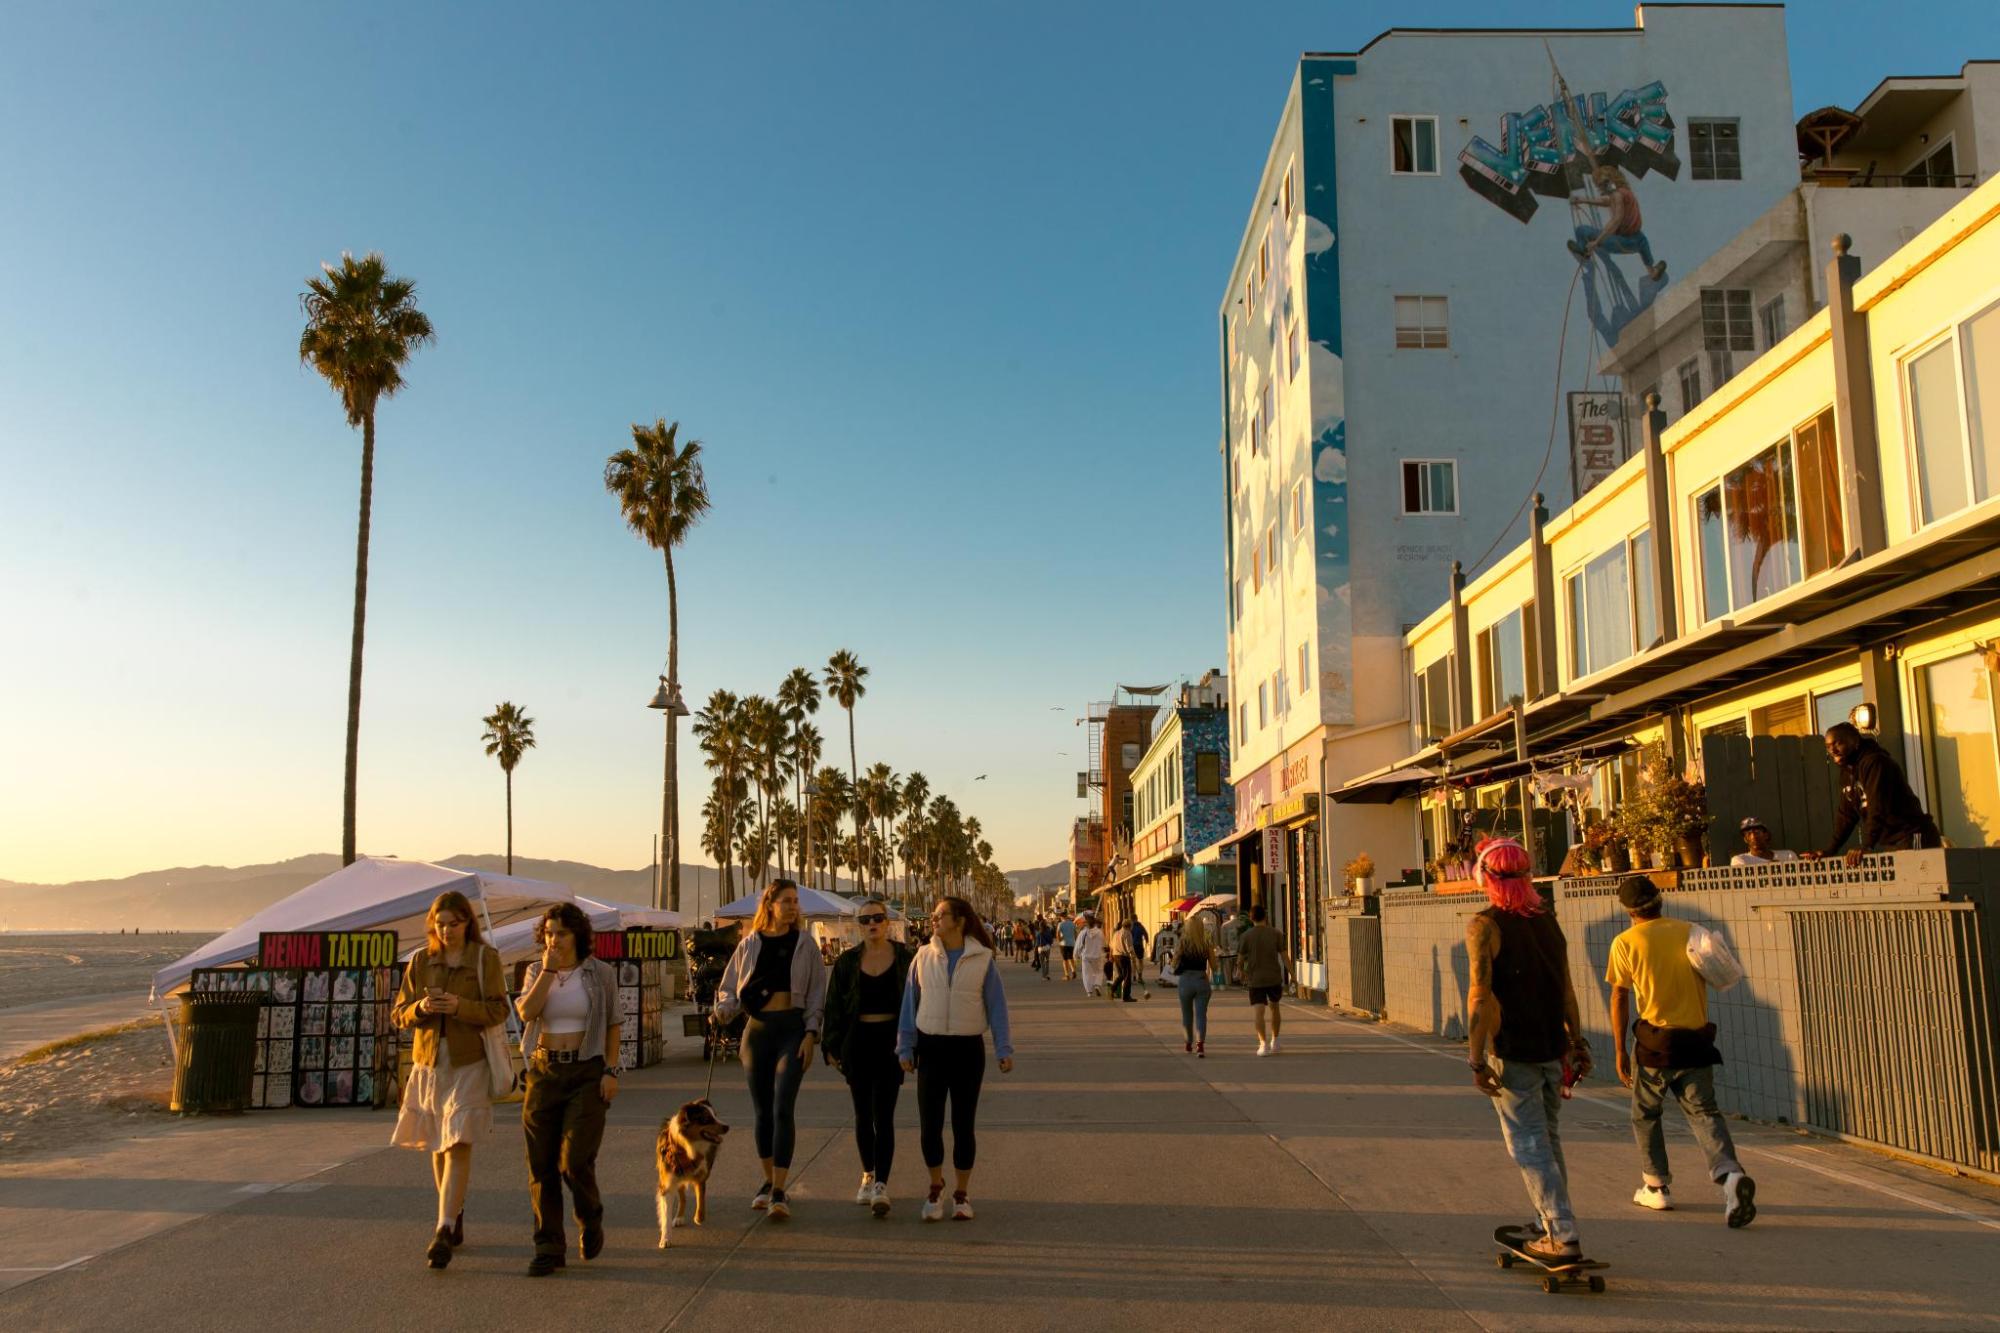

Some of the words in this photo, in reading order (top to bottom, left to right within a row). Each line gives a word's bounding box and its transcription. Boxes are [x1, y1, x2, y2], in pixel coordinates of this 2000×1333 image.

[1578, 399, 1609, 419] The
[1280, 755, 1308, 792] MARKET
[1269, 829, 1280, 871] MARKET
[263, 934, 322, 968] HENNA
[328, 932, 394, 968] TATTOO
[596, 932, 624, 959] NNA
[627, 931, 675, 958] TATTOO
